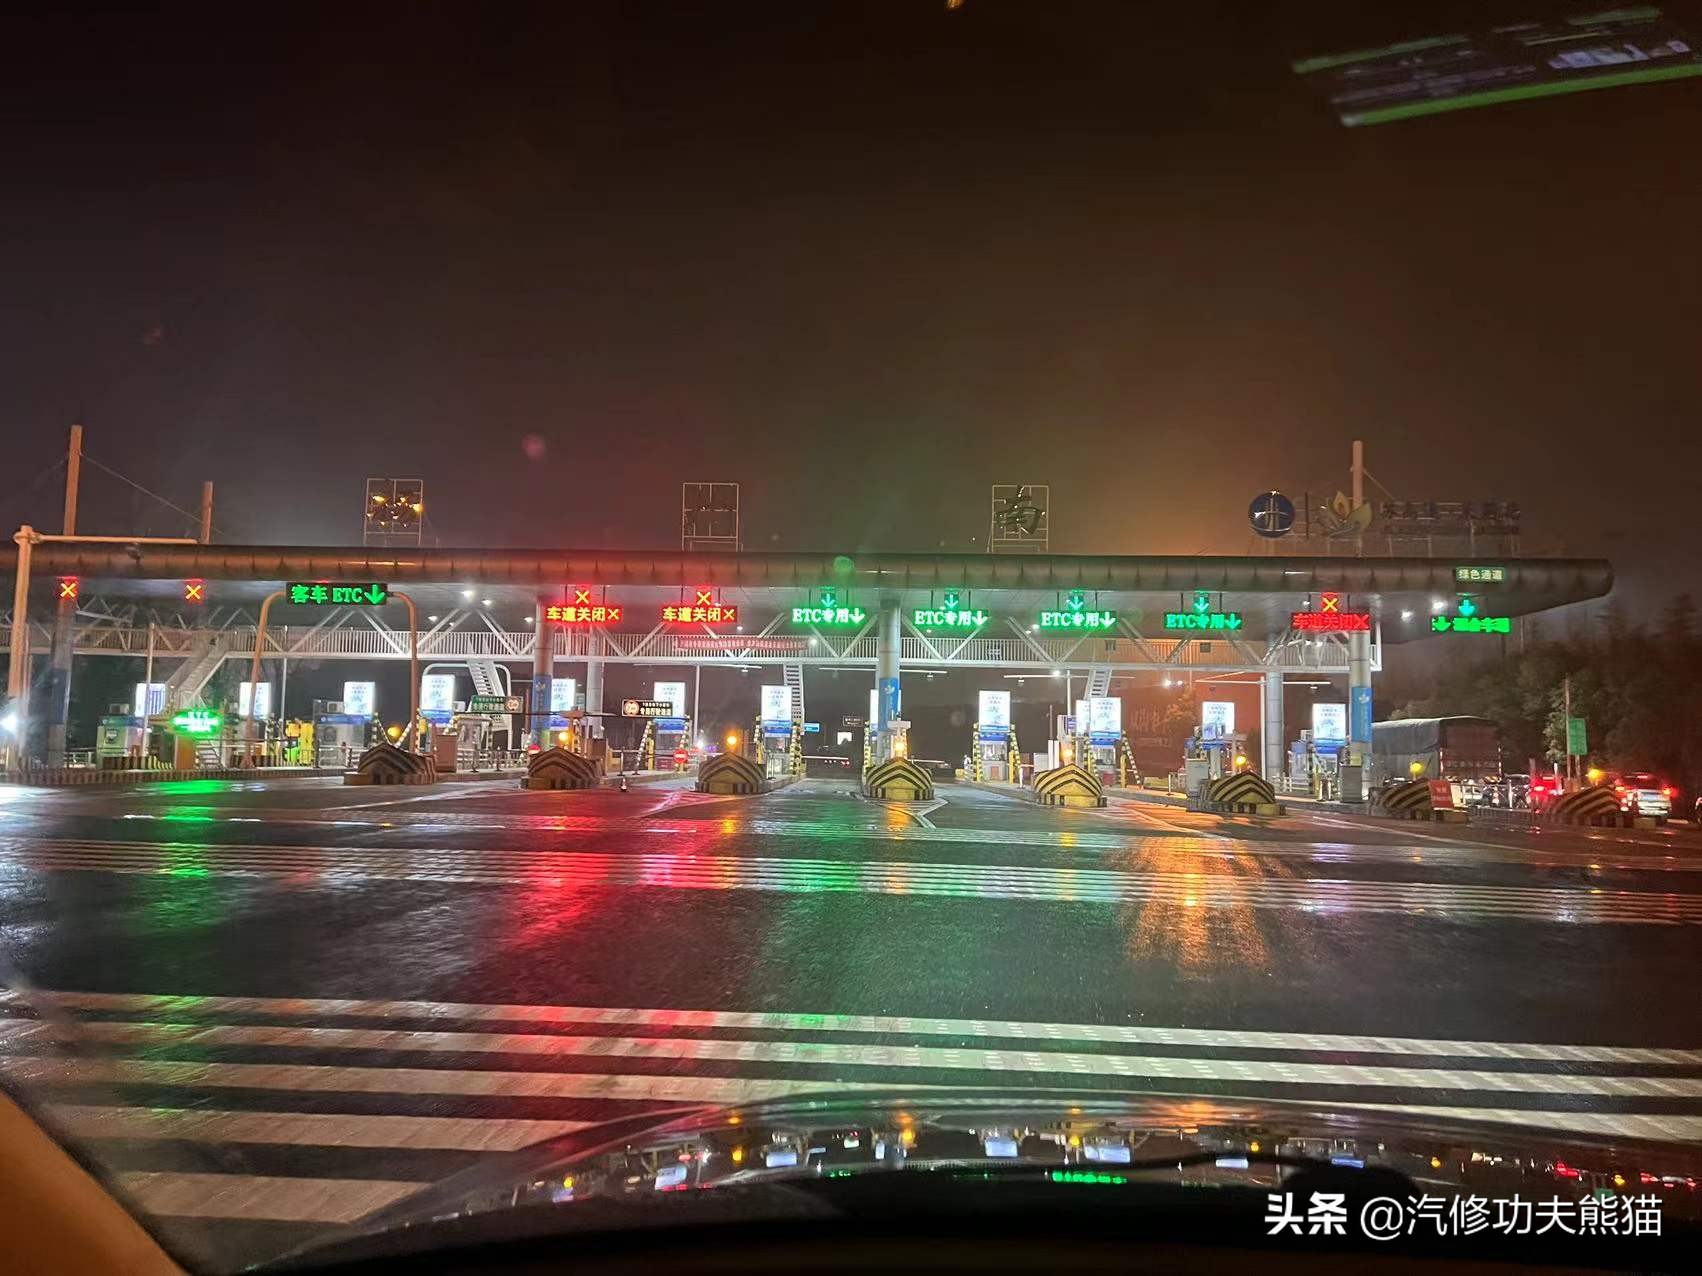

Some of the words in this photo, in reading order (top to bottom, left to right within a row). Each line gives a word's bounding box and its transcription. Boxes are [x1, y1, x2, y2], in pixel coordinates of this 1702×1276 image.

[290, 584, 328, 604] 客车
[332, 587, 363, 603] ETC
[547, 607, 606, 622] 车道关闭
[663, 607, 722, 622] 车道关闭
[792, 607, 849, 623] ETC专用
[914, 610, 972, 626] ETC专用
[1041, 611, 1099, 627] ETC专用
[1166, 613, 1225, 629] ETC专用
[1292, 613, 1353, 629] 车道关闭
